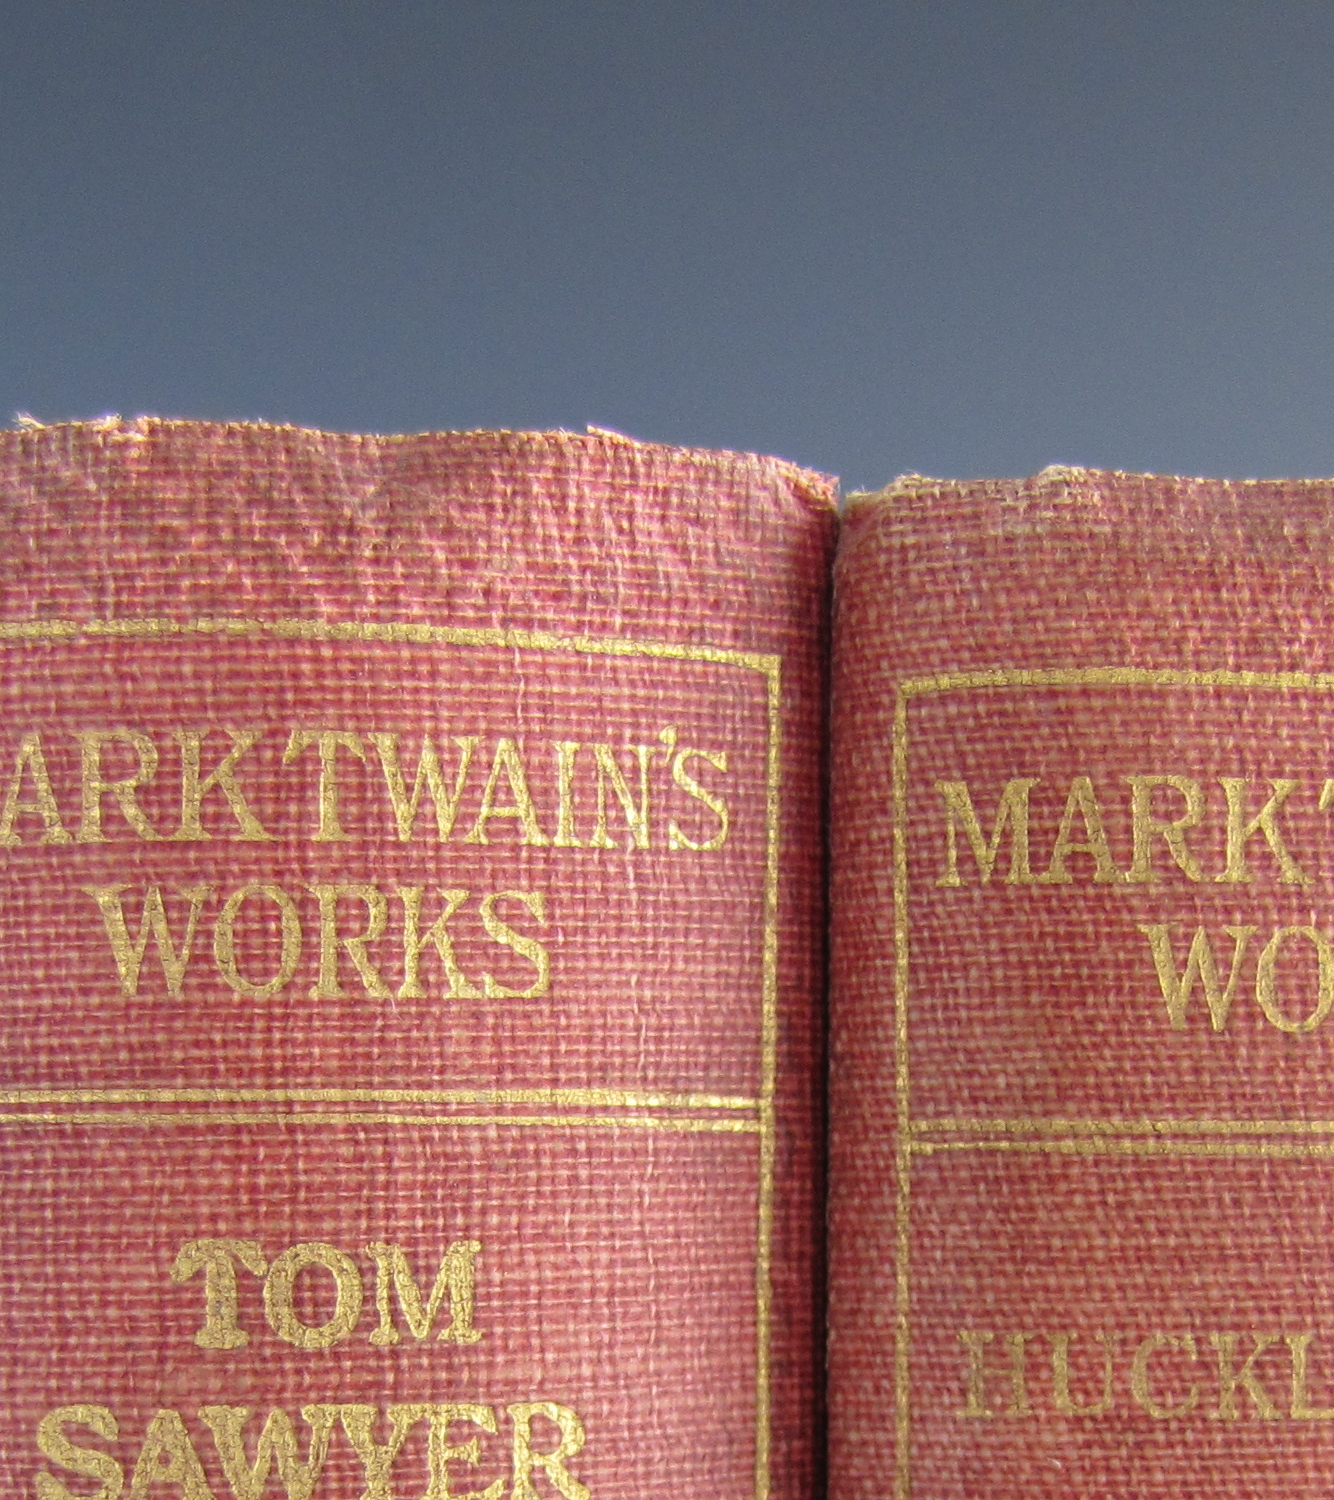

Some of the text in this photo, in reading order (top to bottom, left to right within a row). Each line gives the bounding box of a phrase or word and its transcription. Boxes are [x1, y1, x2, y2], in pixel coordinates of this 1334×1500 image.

[283, 725, 729, 851] TWAIN'S
[936, 775, 1315, 888] MARK
[83, 883, 551, 1000] WORKS
[170, 1238, 483, 1348] TOM
